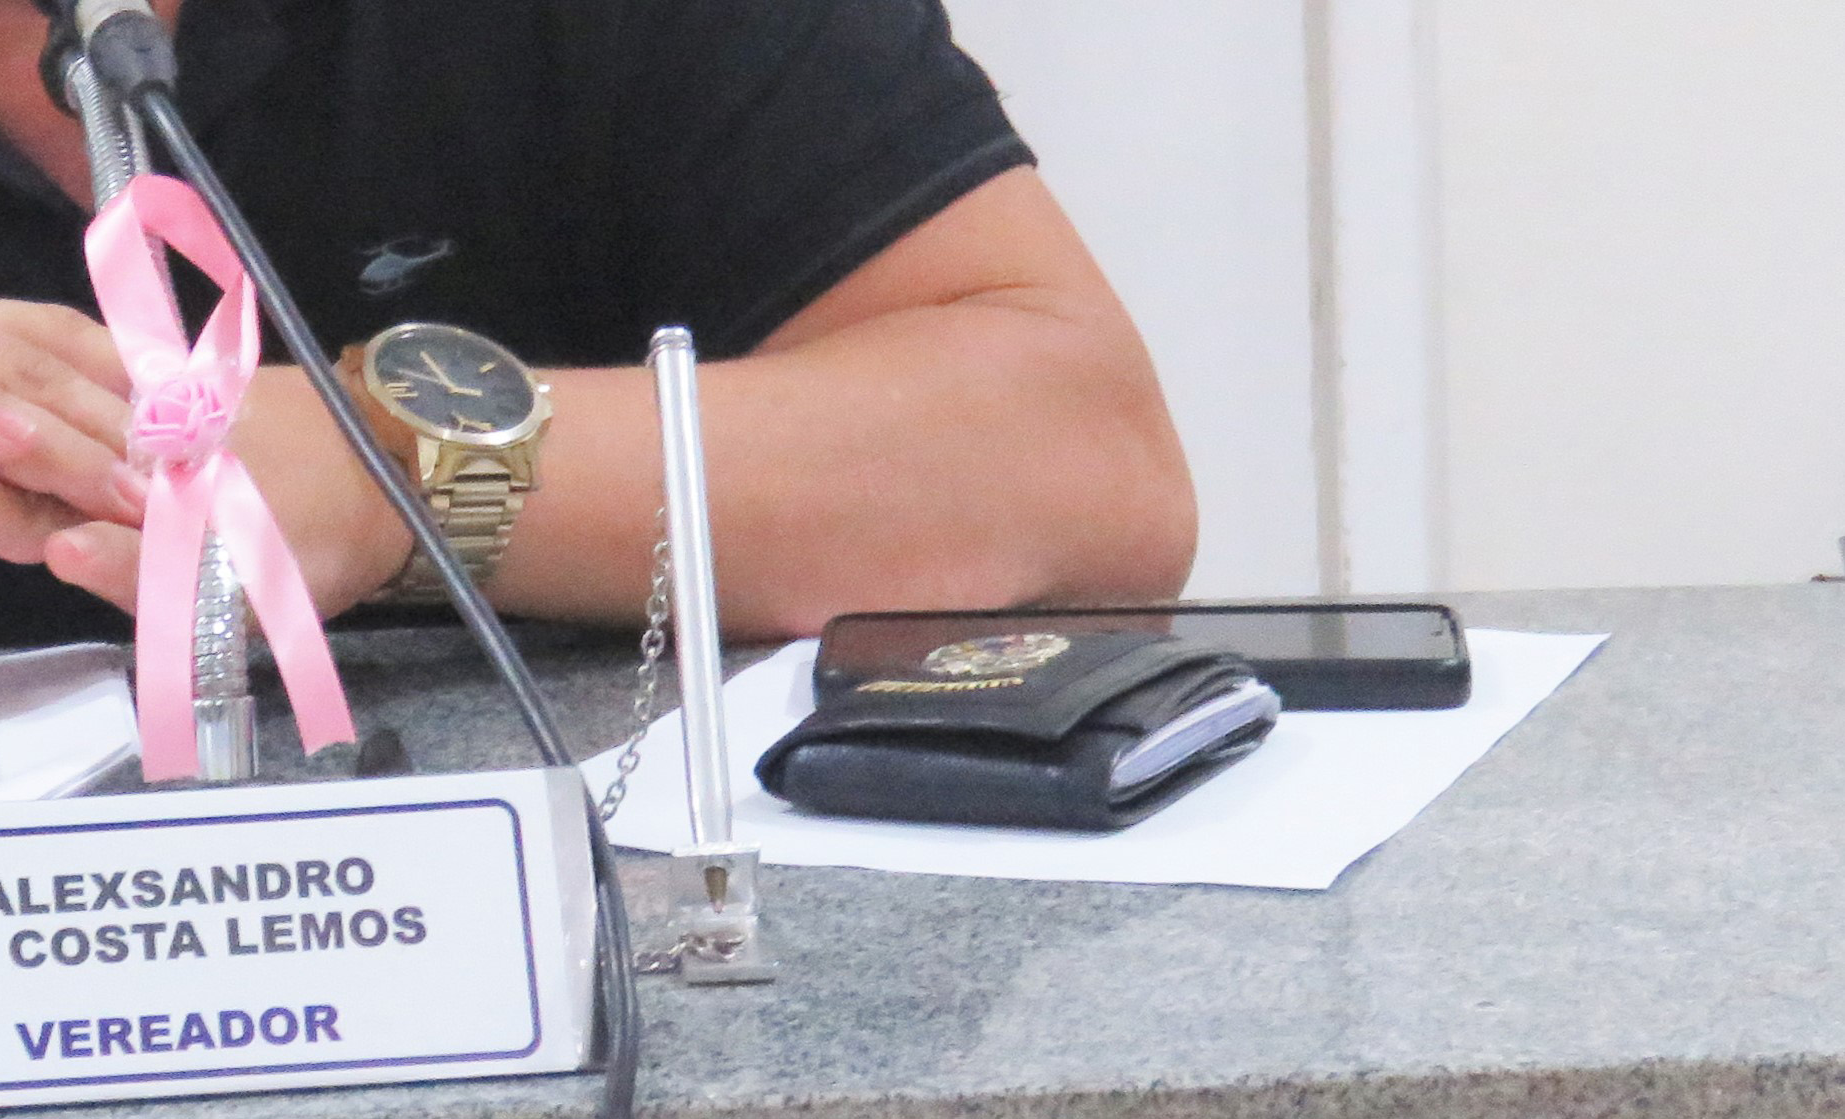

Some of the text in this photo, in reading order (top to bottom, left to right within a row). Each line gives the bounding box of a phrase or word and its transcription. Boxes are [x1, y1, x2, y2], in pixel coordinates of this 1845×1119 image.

[9, 920, 206, 968] COSTA
[227, 906, 427, 956] LEMOS
[14, 1004, 341, 1061] VEREADOR
